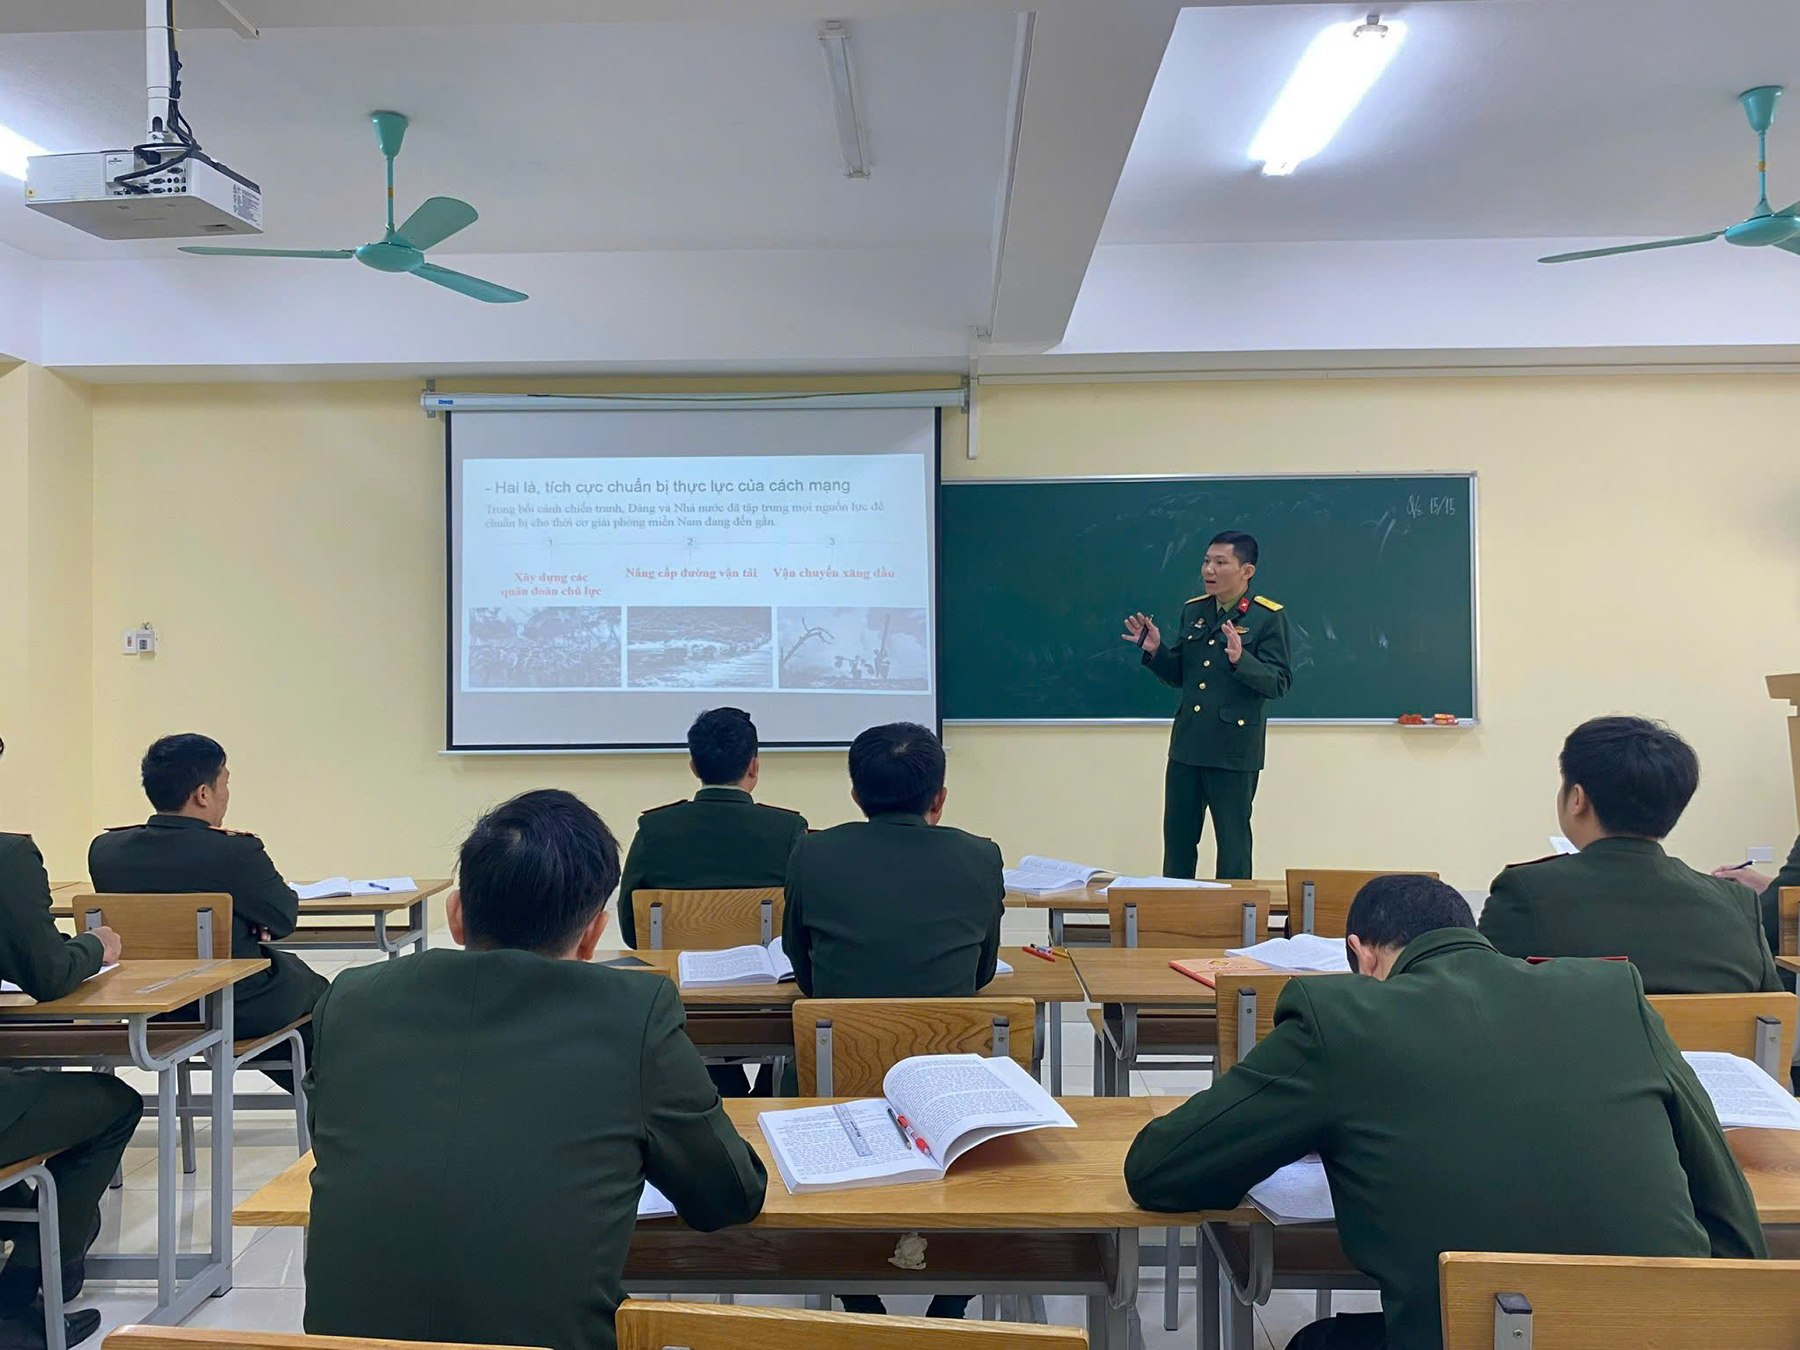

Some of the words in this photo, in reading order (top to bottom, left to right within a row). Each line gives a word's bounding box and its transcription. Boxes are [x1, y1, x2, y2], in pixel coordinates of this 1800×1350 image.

[495, 481, 519, 494] Hai
[524, 481, 540, 494] là,
[545, 481, 570, 493] tích
[576, 482, 603, 496] cực
[608, 478, 651, 493] chuẩn
[656, 481, 669, 495] bị
[673, 479, 707, 495] thực
[711, 480, 734, 495] lực
[738, 479, 764, 492] của
[769, 479, 804, 492] cách
[809, 480, 850, 494] mạng
[486, 505, 515, 514] Trong
[595, 504, 624, 514] tranh,
[727, 503, 740, 512] đã
[762, 504, 789, 514] trung
[531, 518, 549, 527] cho
[677, 518, 702, 526] Nam
[705, 517, 730, 529] đang
